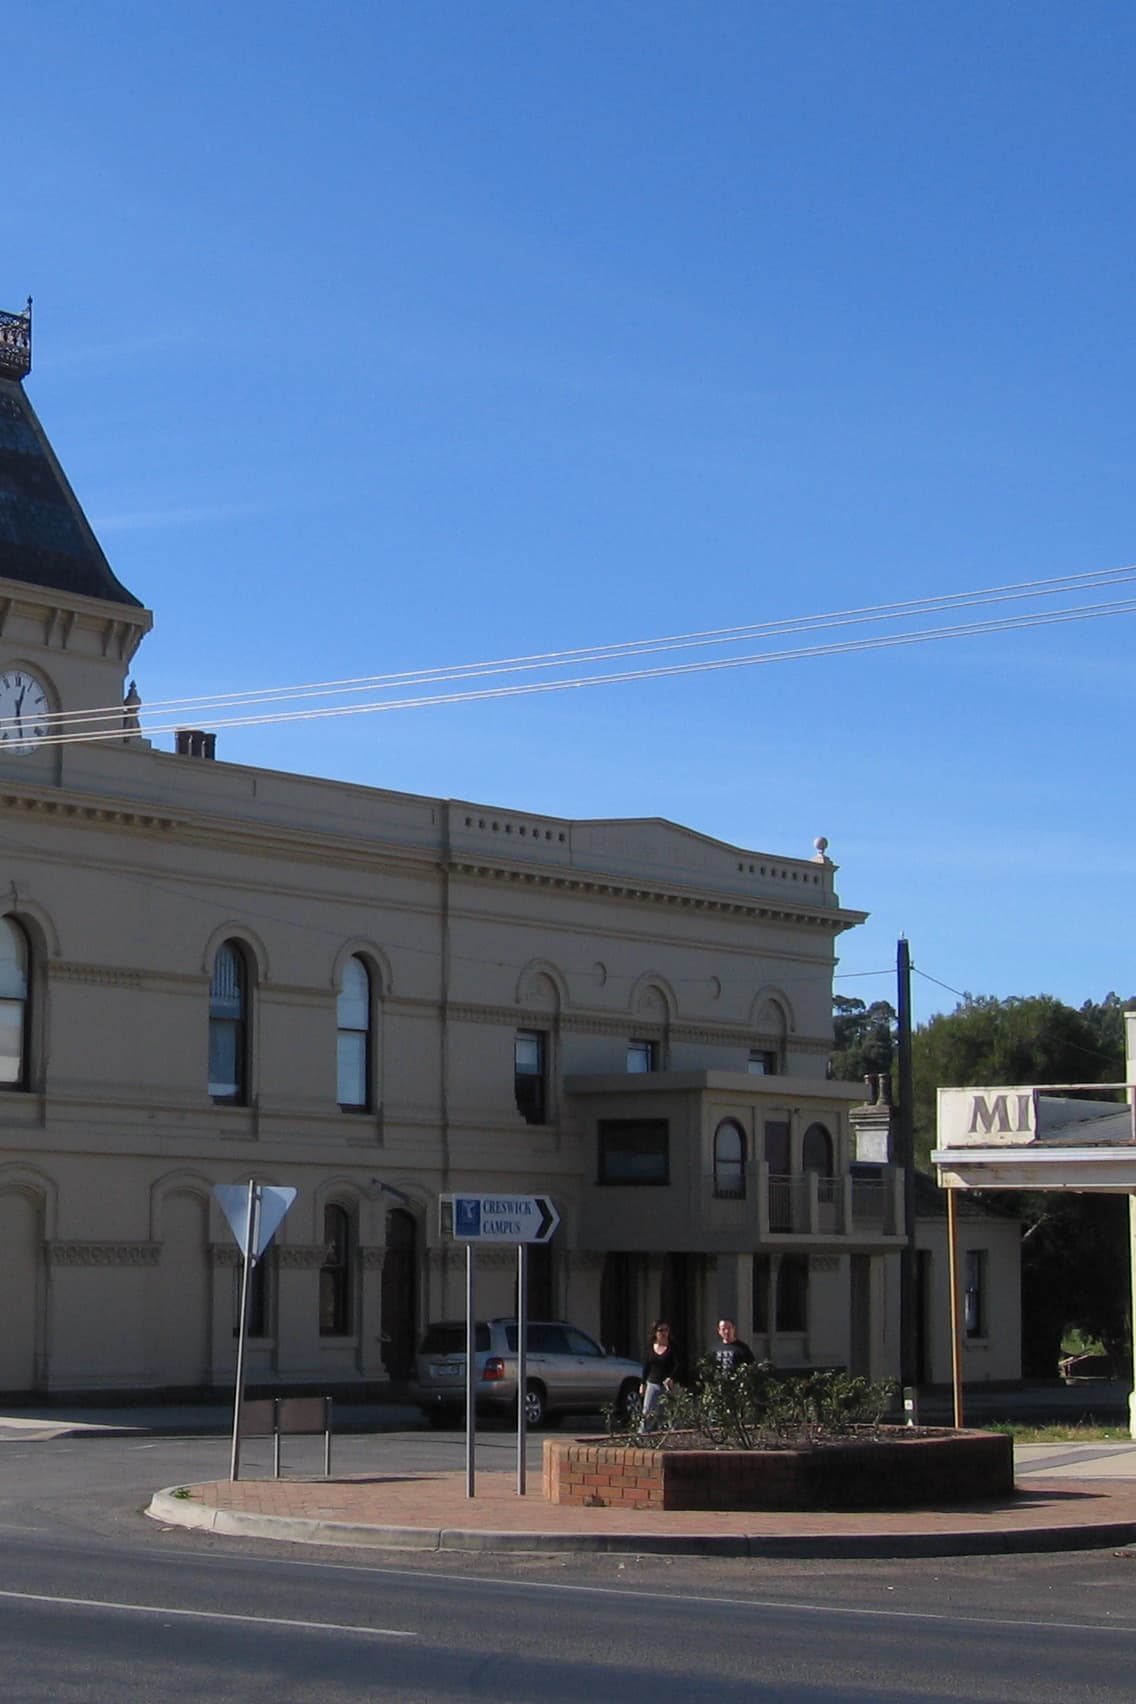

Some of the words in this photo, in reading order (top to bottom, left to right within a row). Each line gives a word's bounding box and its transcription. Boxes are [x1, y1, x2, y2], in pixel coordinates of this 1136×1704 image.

[968, 1095, 1032, 1133] MI
[483, 1200, 531, 1215] CRESWICK
[483, 1220, 521, 1234] CAMPUS
